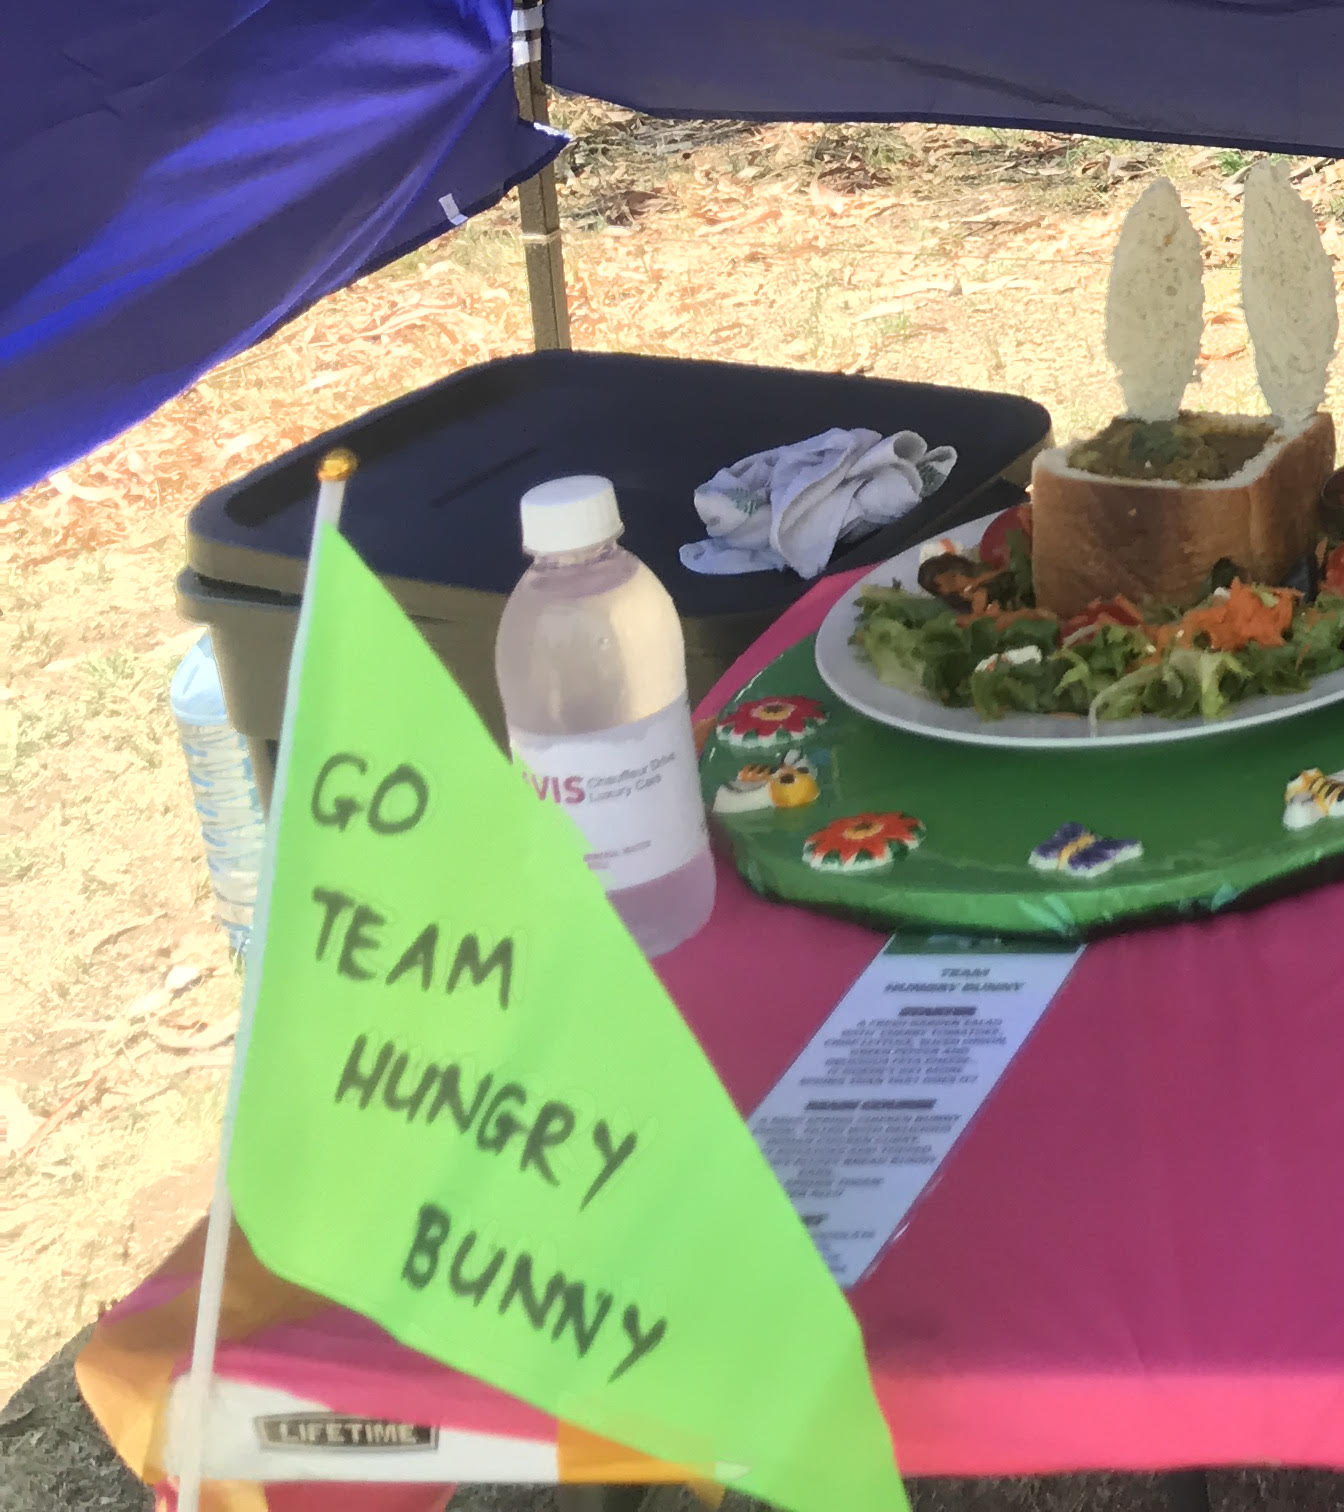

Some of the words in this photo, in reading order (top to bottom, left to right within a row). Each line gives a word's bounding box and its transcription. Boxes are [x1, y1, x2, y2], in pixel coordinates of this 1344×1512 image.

[310, 751, 430, 835] GO
[311, 887, 517, 1010] TEAM
[334, 1034, 638, 1210] HUNGRY
[401, 1202, 668, 1382] BUNNY
[280, 1422, 417, 1444] LIFETIME
